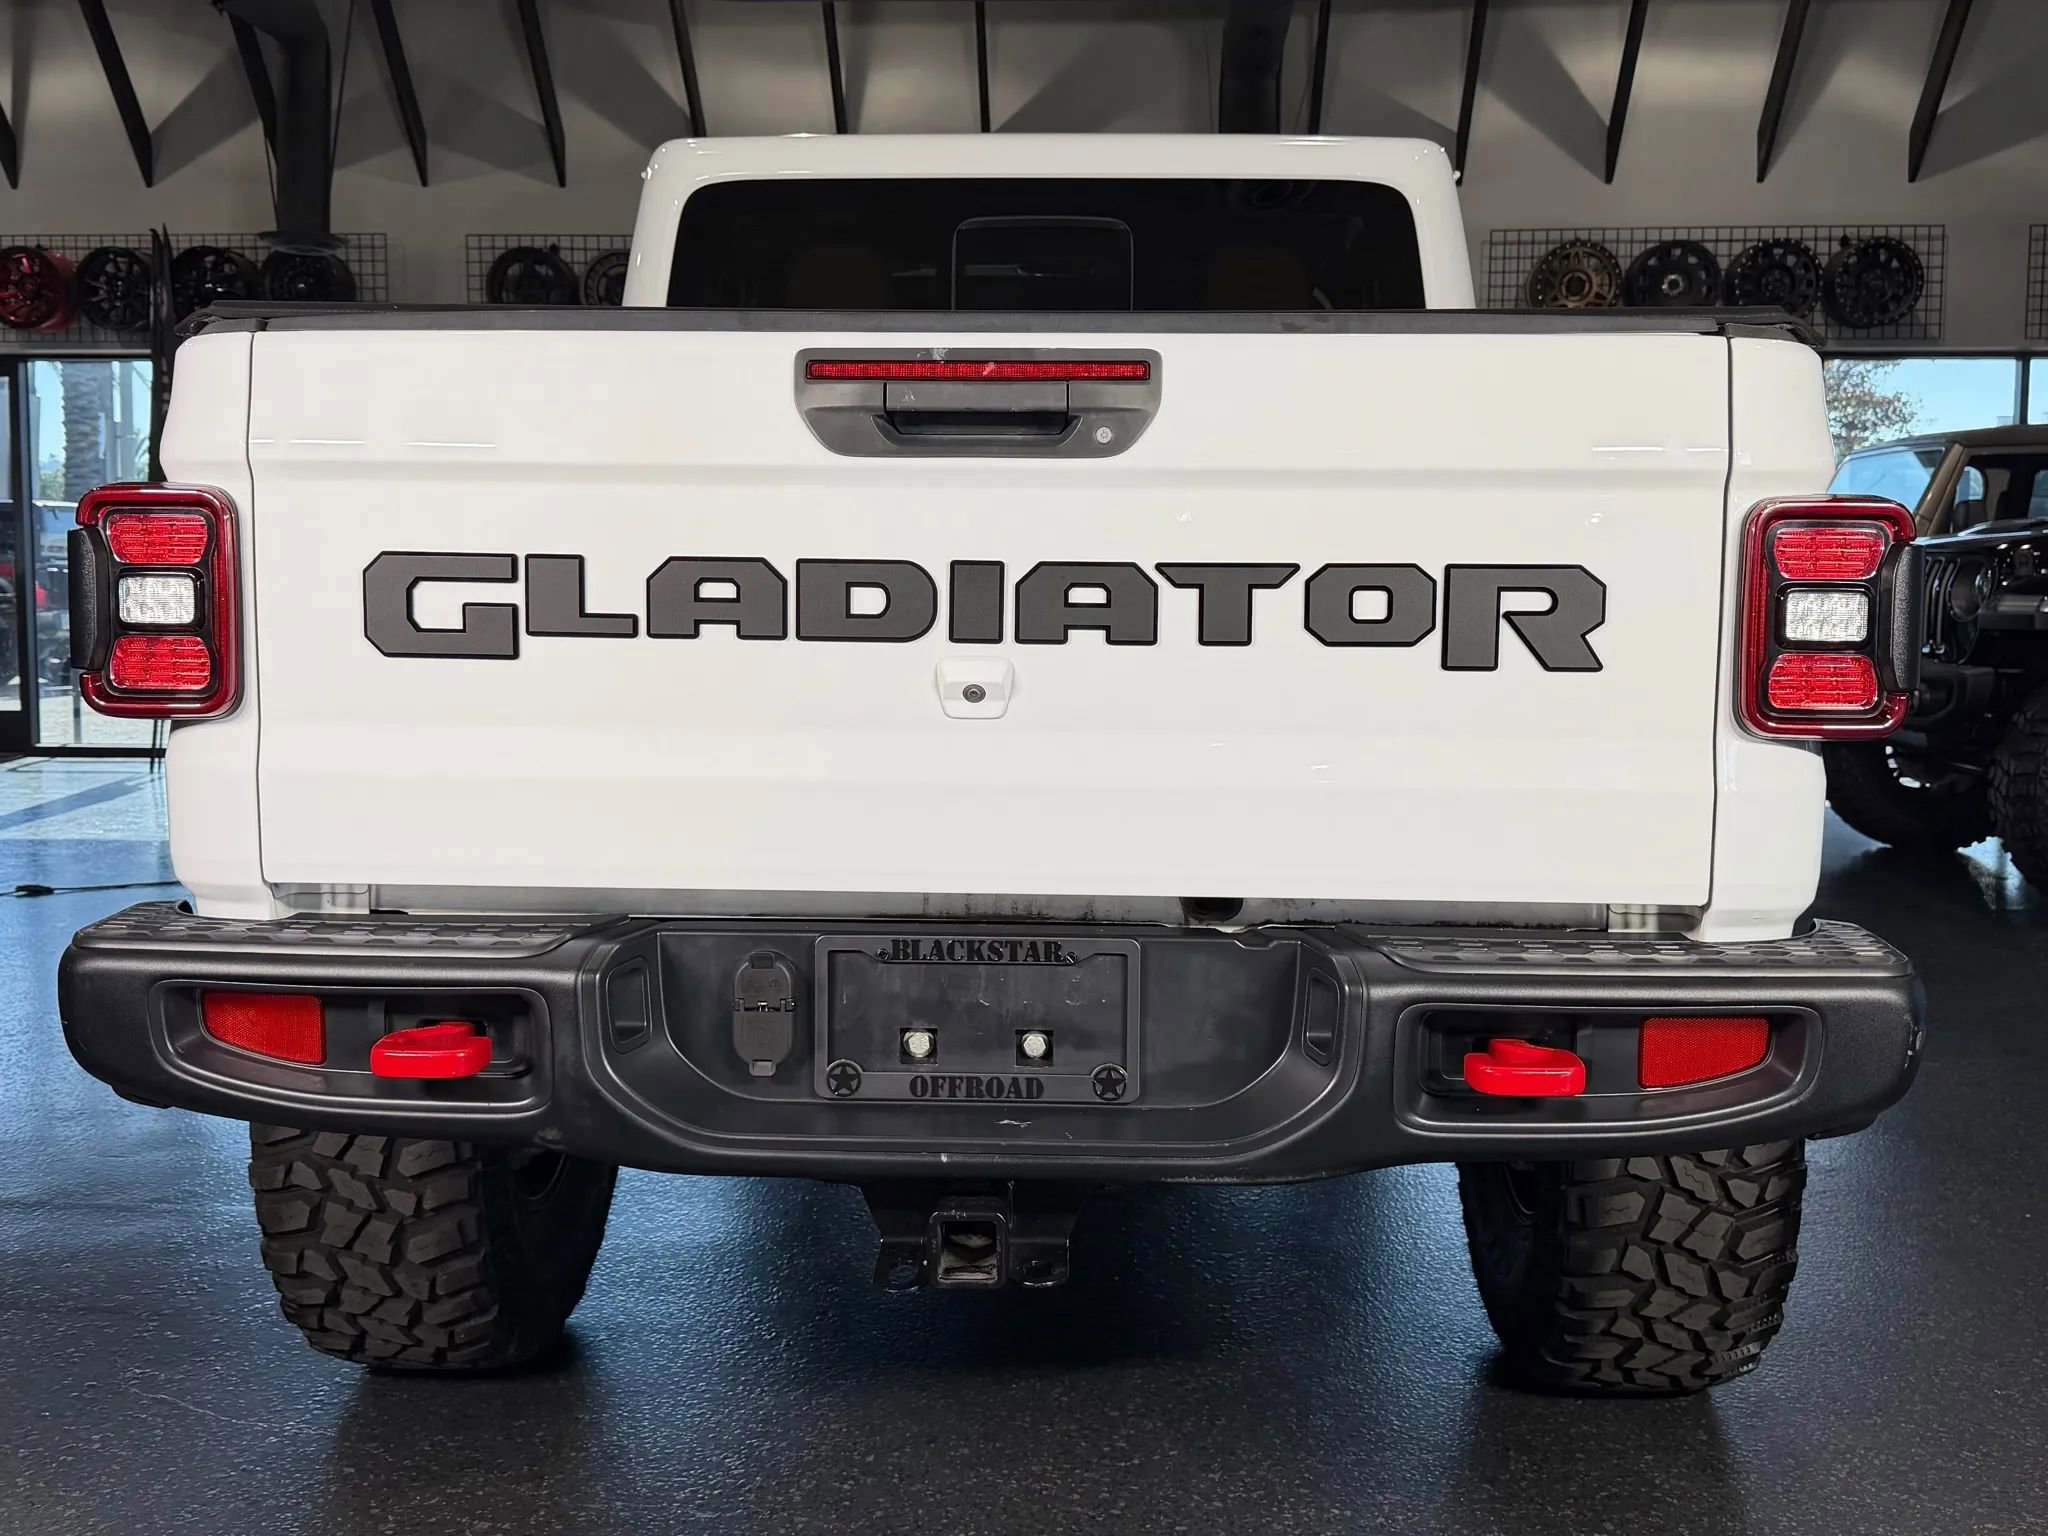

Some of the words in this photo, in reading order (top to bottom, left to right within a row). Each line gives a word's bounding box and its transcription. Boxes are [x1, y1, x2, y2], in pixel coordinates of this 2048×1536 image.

[363, 551, 1606, 672] GLADIATOR
[891, 938, 1064, 963] BLACKSTAR
[909, 1075, 1044, 1099] OFFROAD
